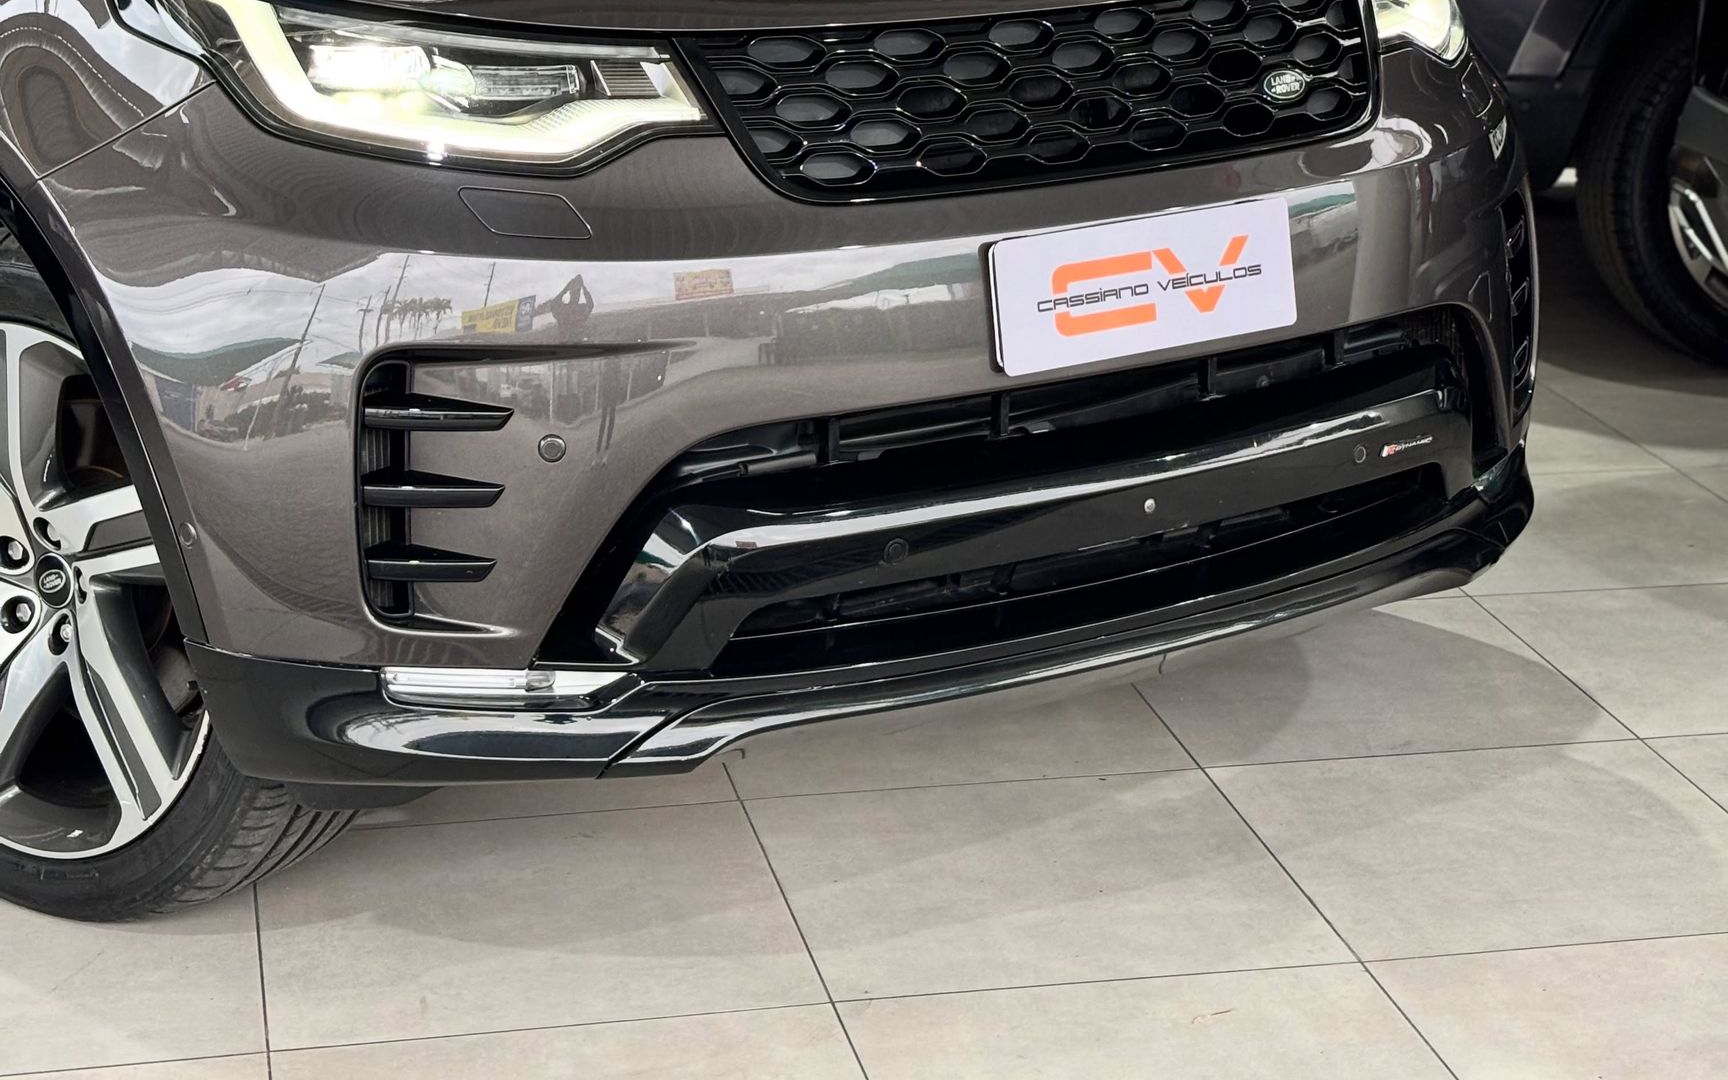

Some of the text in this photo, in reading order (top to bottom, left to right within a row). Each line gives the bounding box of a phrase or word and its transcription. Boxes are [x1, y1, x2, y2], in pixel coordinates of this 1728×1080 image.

[1271, 74, 1291, 86] LAND
[1276, 81, 1300, 94] ROVER
[1037, 264, 1262, 313] CASSIANO VEÍCULOS
